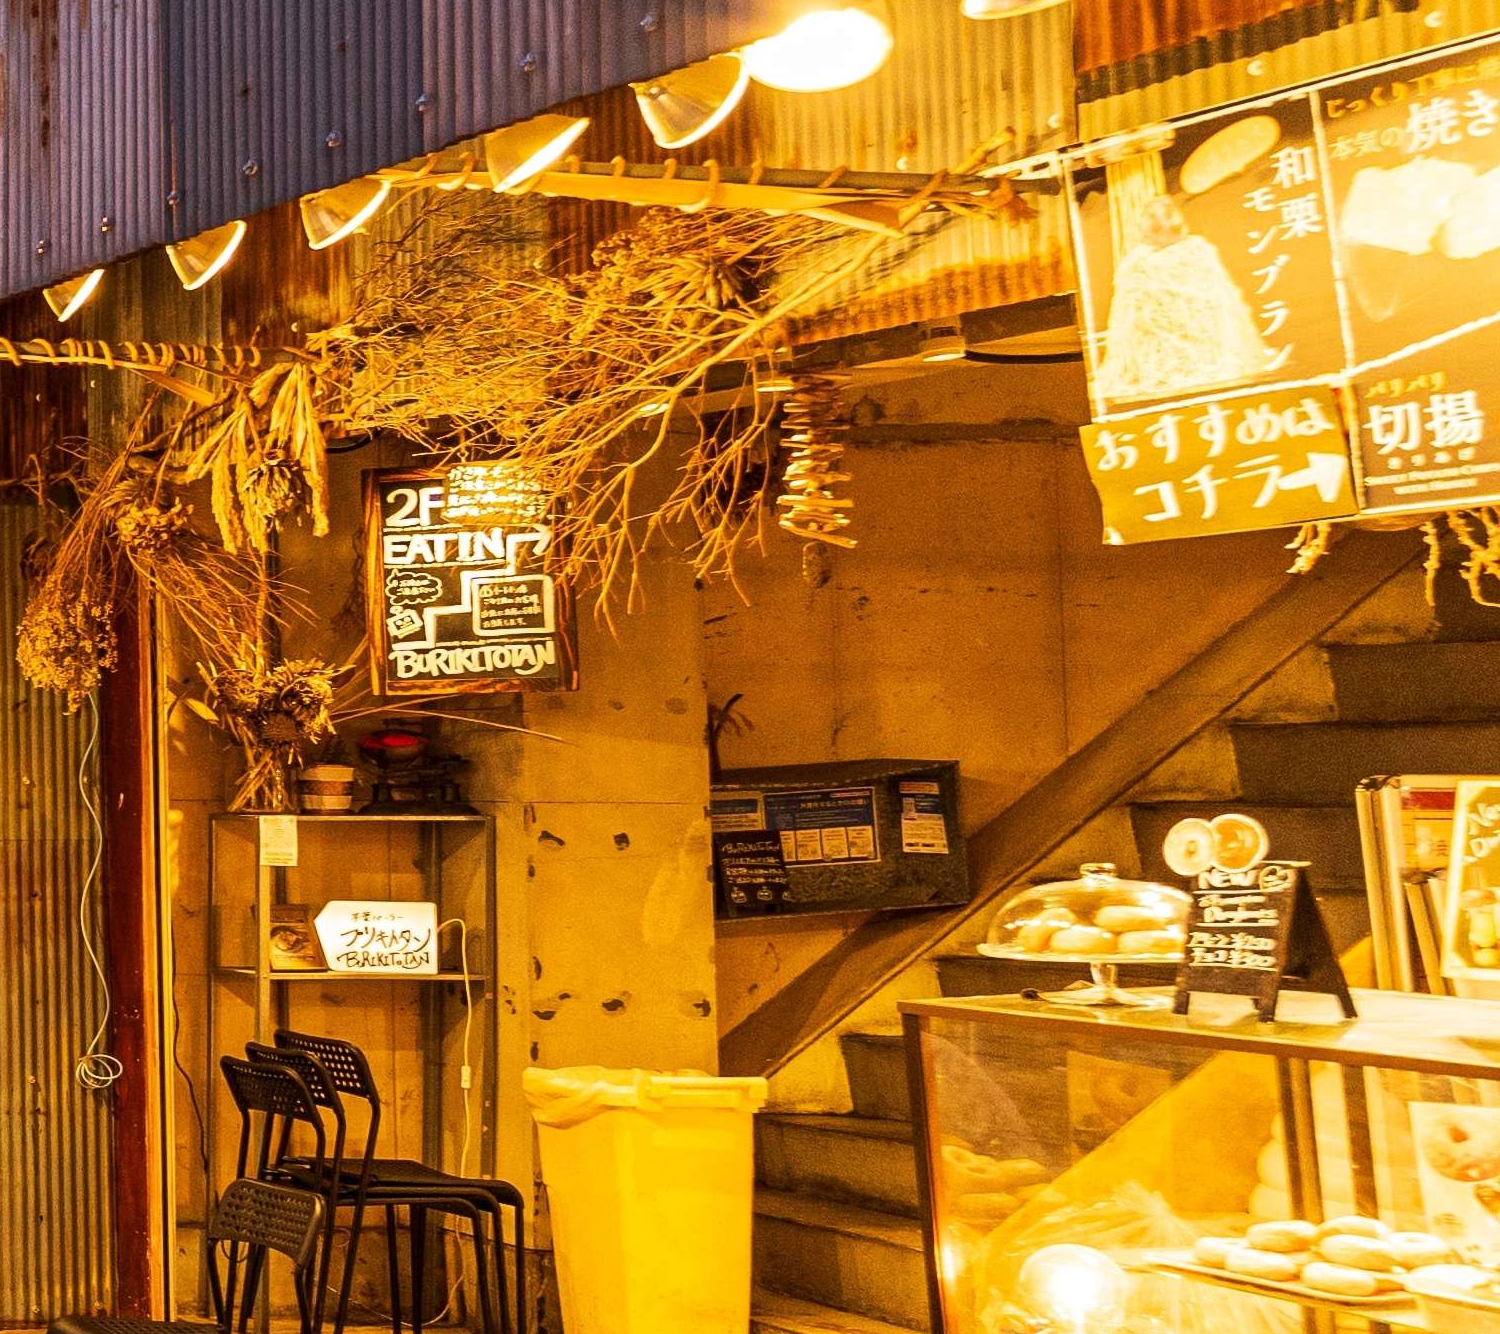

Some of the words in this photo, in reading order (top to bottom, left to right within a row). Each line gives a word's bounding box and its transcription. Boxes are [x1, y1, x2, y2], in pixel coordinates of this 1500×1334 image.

[1270, 144, 1322, 240] 和栗
[1243, 187, 1290, 372] モンブラン
[1093, 394, 1337, 472] おすすめは
[1362, 389, 1485, 455] 切揚
[385, 486, 446, 528] 2F
[1132, 451, 1286, 523] コチラ
[340, 926, 431, 953] ブリキトタン
